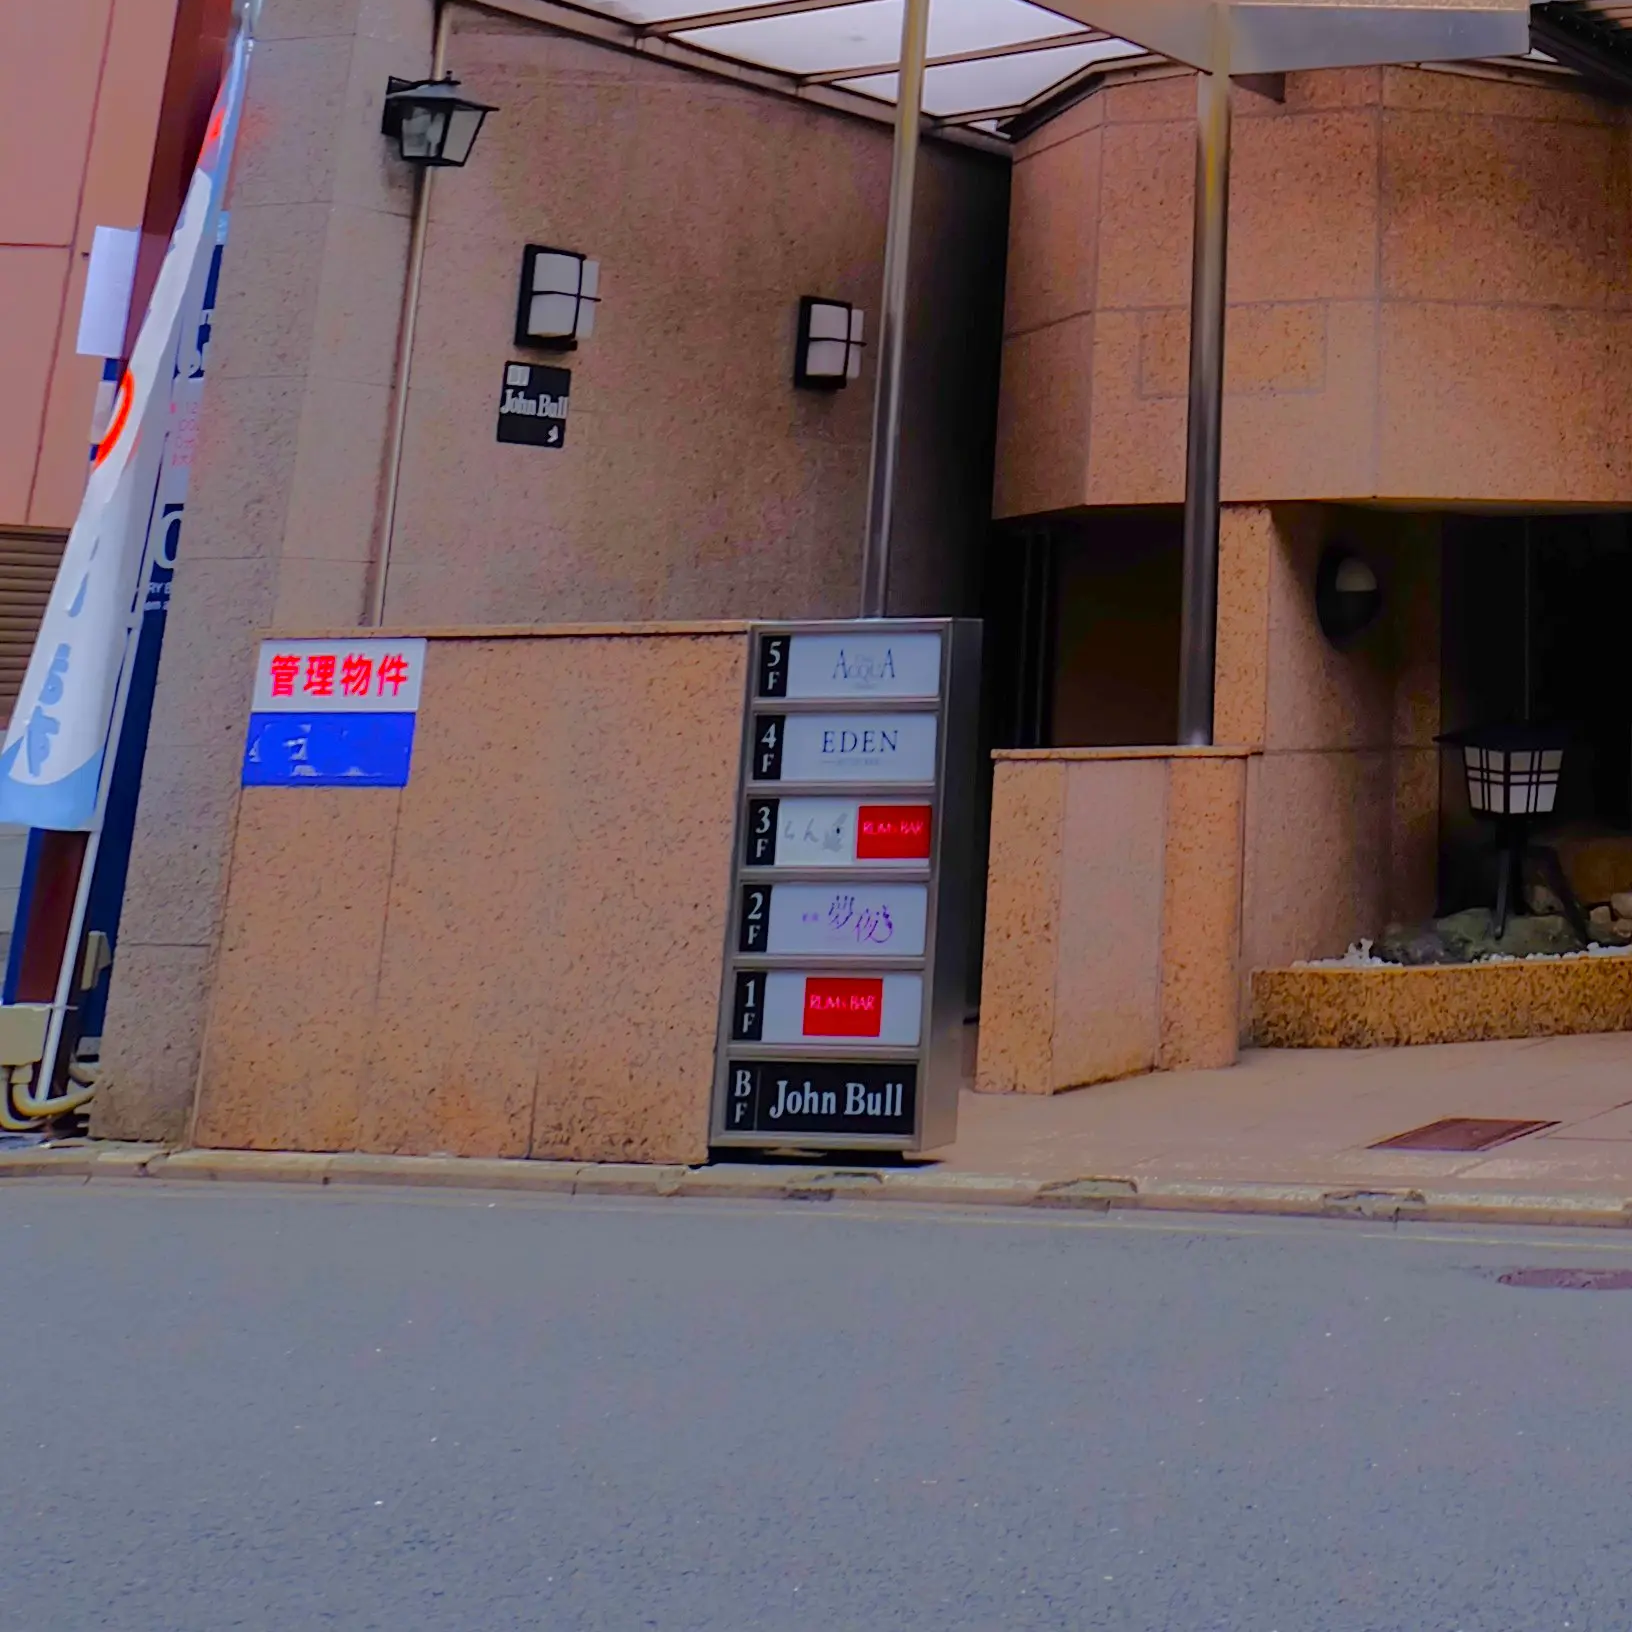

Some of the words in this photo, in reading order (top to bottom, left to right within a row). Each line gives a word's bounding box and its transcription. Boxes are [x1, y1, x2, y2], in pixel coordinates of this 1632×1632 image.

[500, 388, 536, 417] John
[536, 392, 569, 420] Bull
[270, 652, 409, 697] 管理物件
[821, 729, 899, 754] EDEN
[769, 1080, 837, 1119] John
[843, 1082, 903, 1117] Bull
